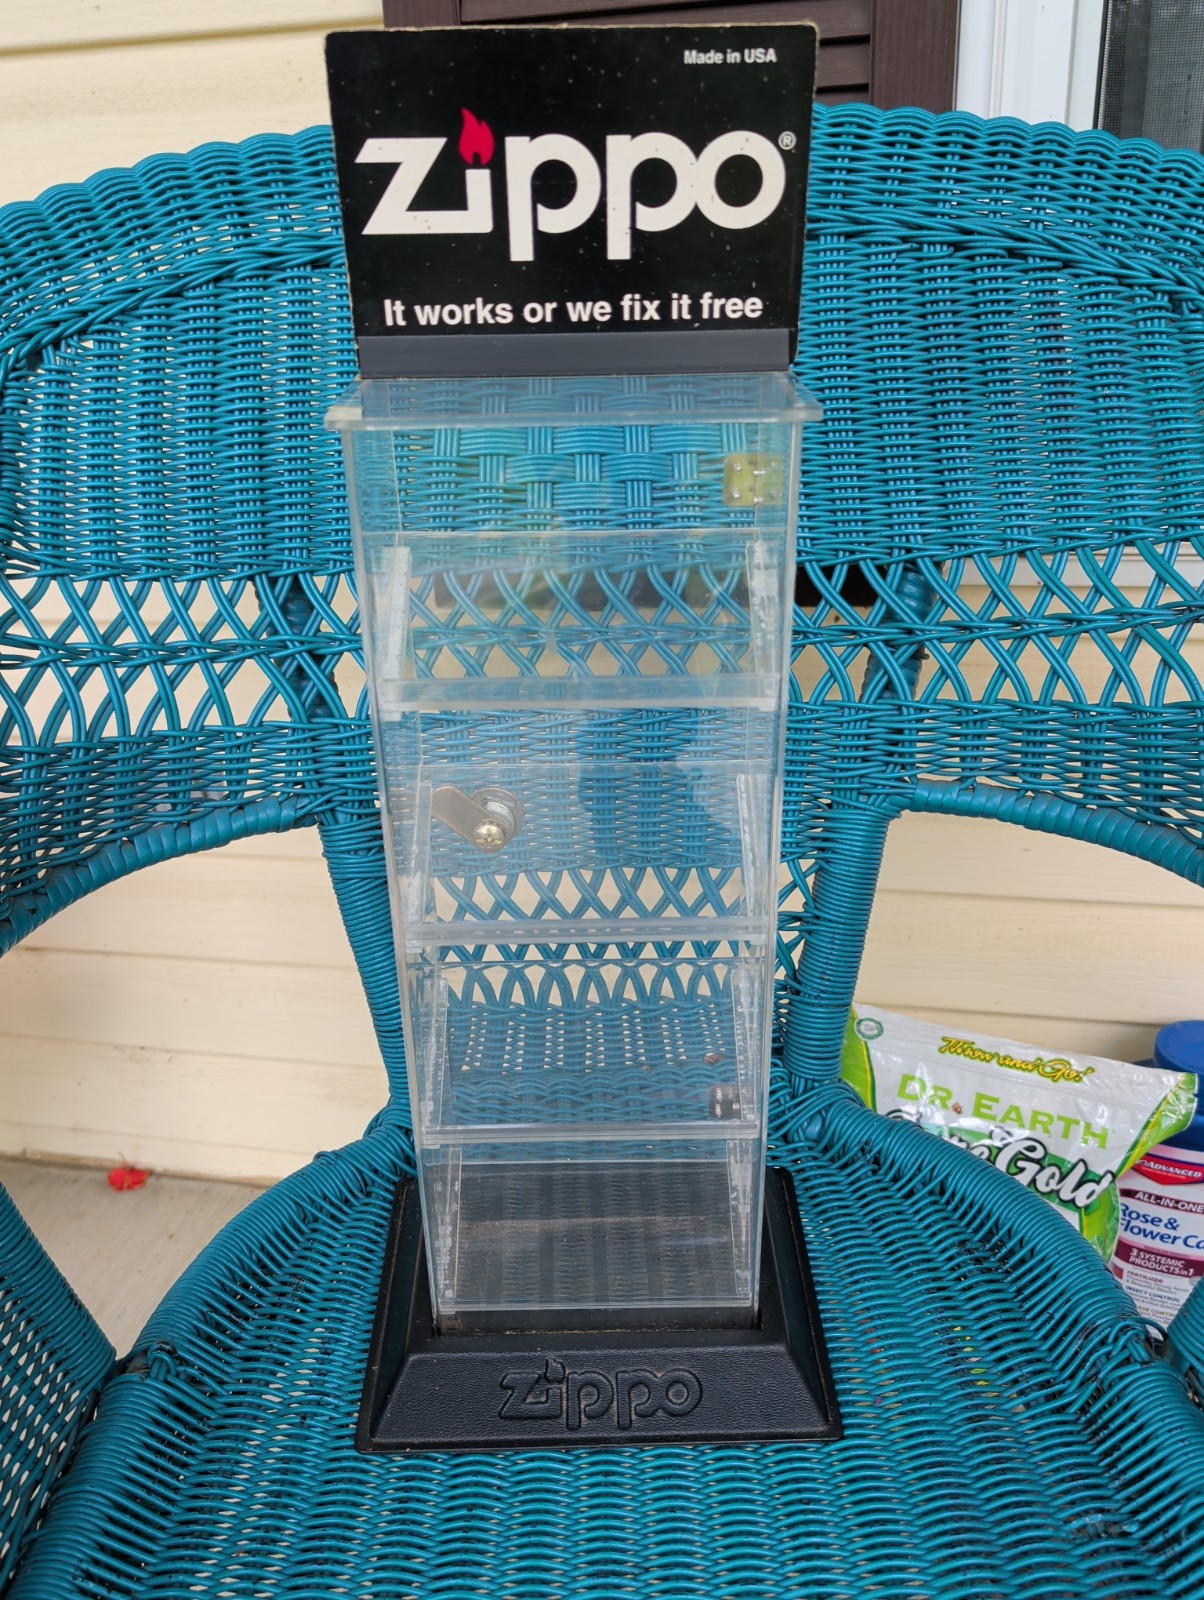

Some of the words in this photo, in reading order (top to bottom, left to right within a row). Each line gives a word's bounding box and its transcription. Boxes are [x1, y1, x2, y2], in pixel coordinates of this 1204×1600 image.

[683, 48, 723, 65] Made
[725, 49, 741, 64] in
[744, 48, 777, 64] USA
[384, 299, 406, 326] It
[413, 297, 514, 325] works
[523, 301, 558, 323] or
[565, 301, 613, 322] we
[620, 294, 661, 322] fix
[671, 294, 692, 320] it
[699, 292, 764, 318] free
[997, 1057, 1041, 1073] and
[1037, 1058, 1096, 1083] Go!
[972, 1091, 1108, 1149] EARTH
[994, 1136, 1116, 1209] Gold
[1134, 1191, 1204, 1213] ALL-IN-ONE
[1163, 1217, 1180, 1231] &
[1129, 1255, 1179, 1275] PRODUCTS
[1130, 1247, 1138, 1256] 3
[1139, 1250, 1185, 1268] SYSTEMIC
